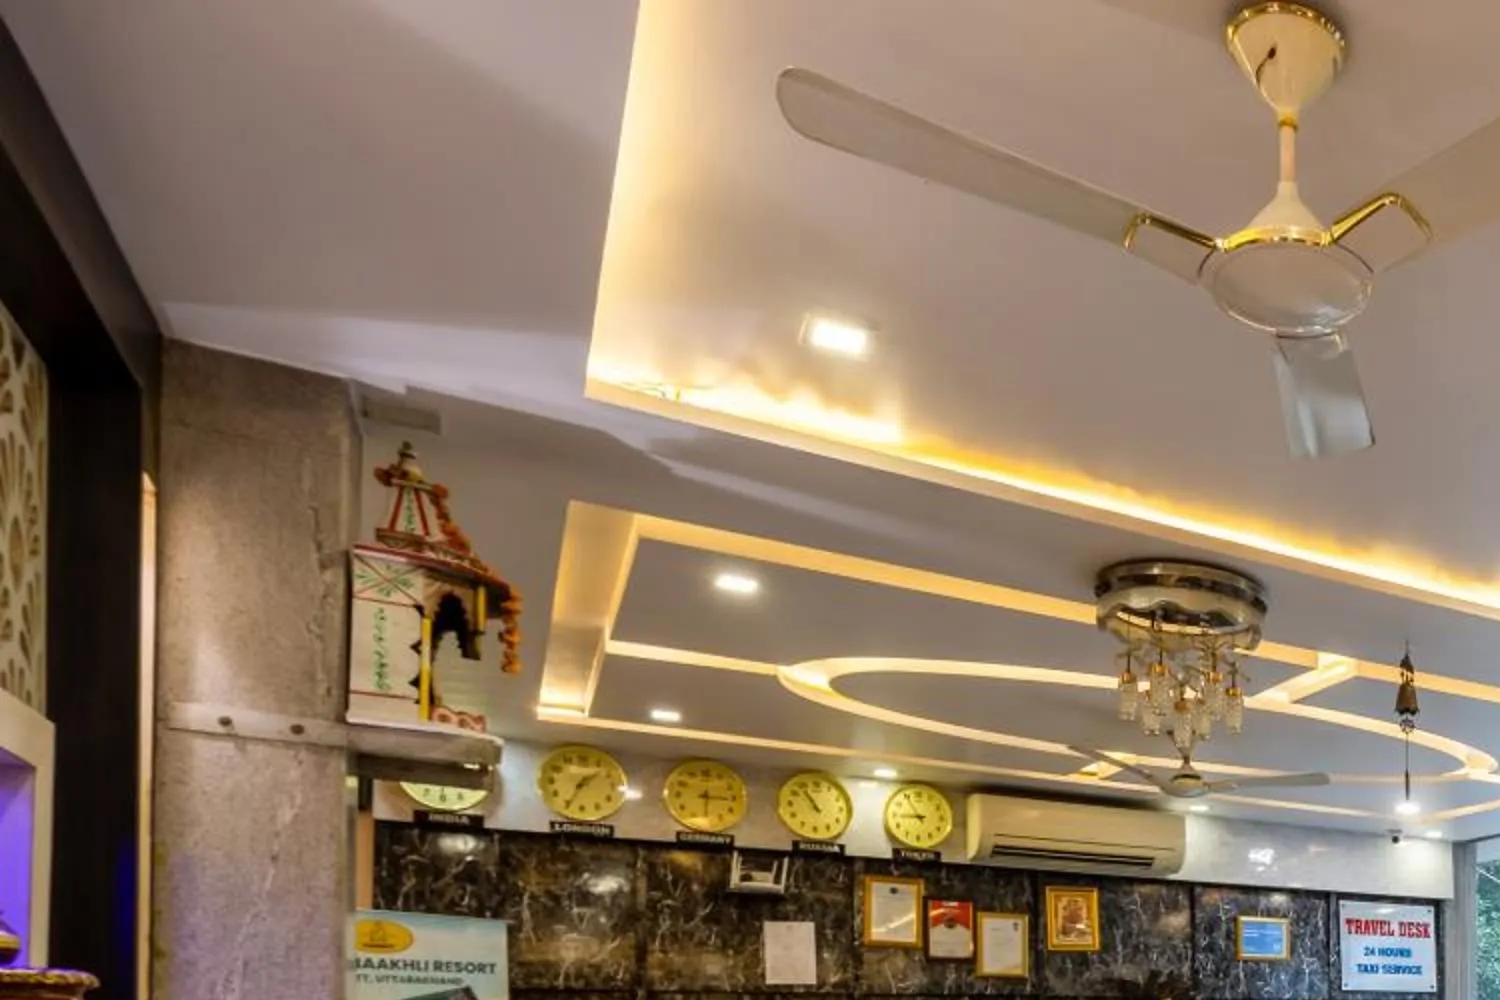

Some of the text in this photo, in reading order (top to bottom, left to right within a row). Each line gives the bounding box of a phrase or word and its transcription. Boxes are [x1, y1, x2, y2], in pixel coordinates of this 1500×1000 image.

[1346, 918, 1430, 938] TRAVEL DESK
[1363, 946, 1412, 958] 24 HOURS
[432, 959, 497, 975] RESORT
[1356, 963, 1423, 975] TAXI SERVICE
